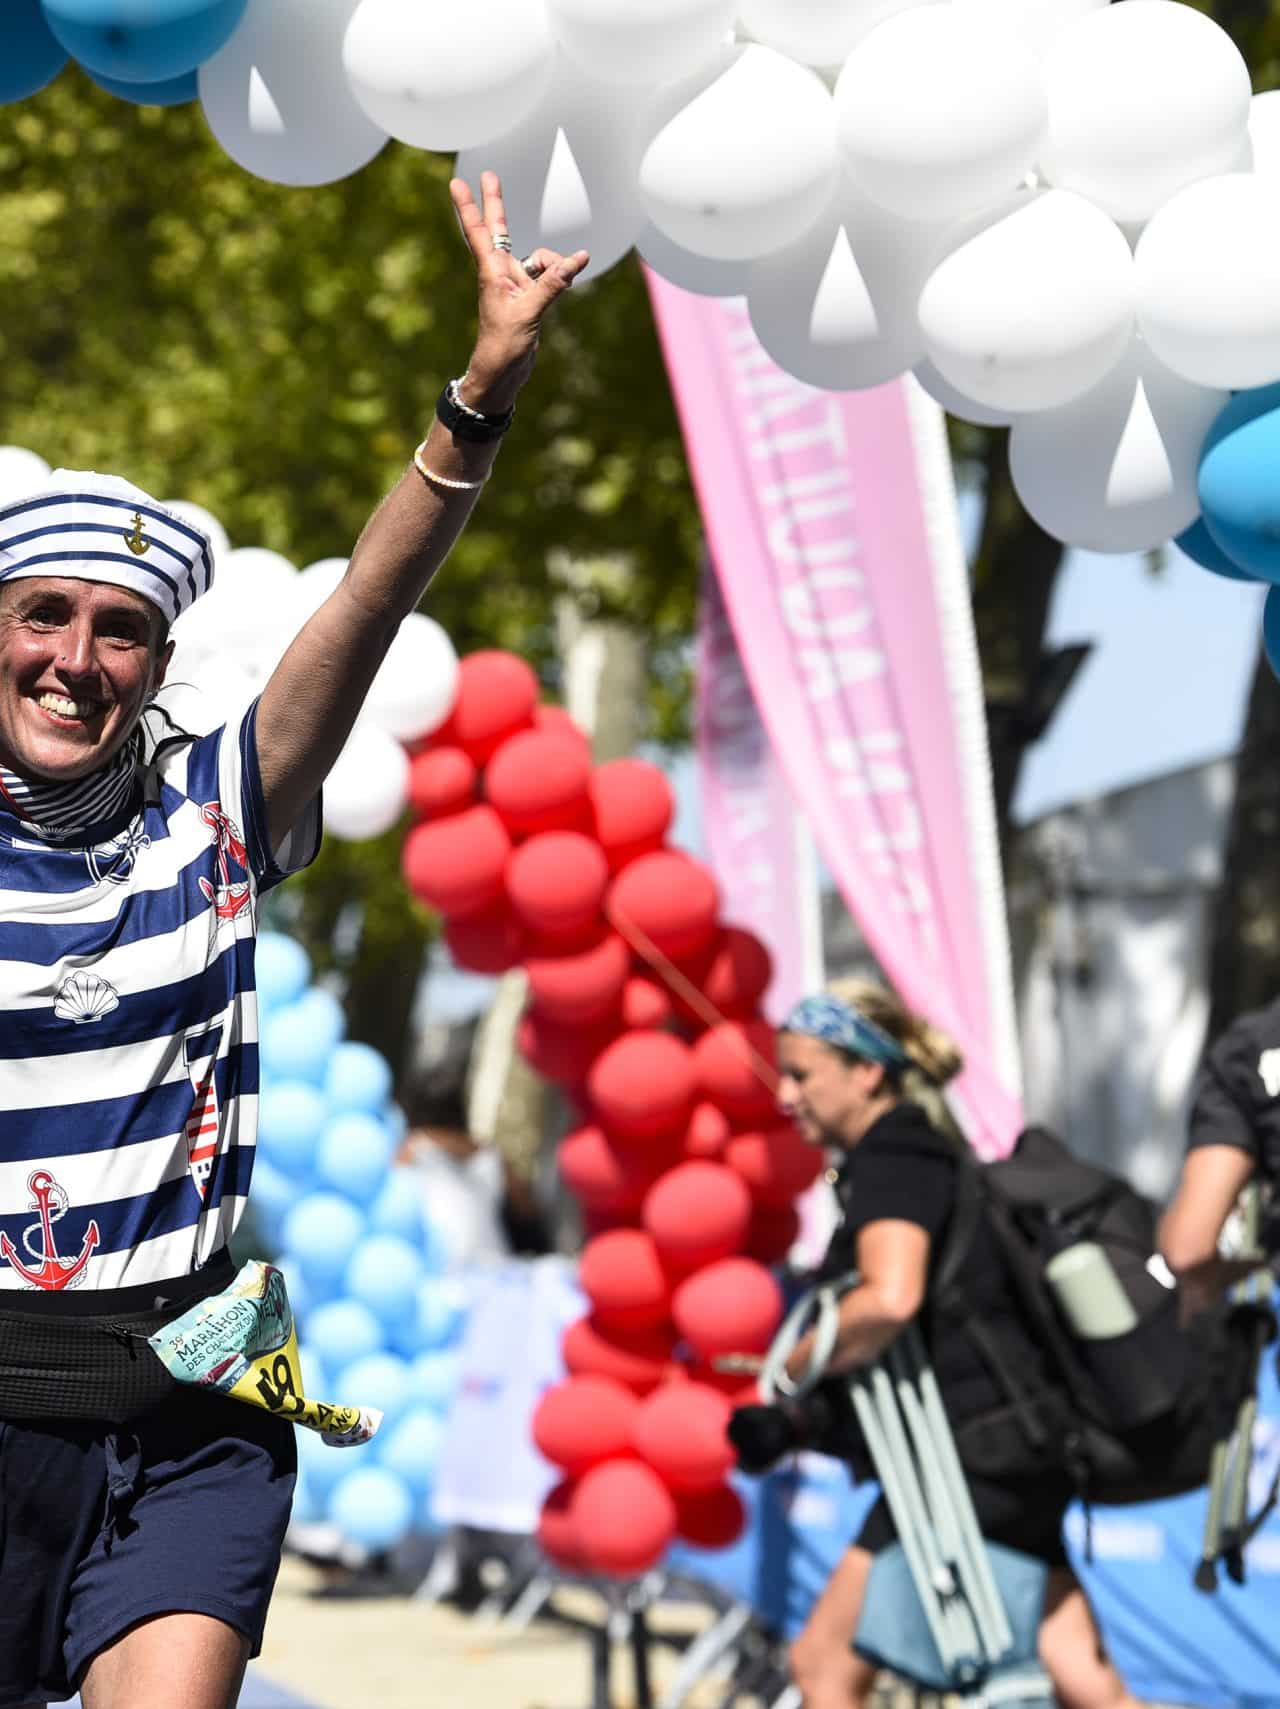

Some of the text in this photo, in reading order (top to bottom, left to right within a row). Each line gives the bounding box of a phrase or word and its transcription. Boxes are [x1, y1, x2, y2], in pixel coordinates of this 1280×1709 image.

[176, 1302, 248, 1363] MARATHON
[185, 1353, 206, 1372] DES
[245, 1312, 257, 1327] DU
